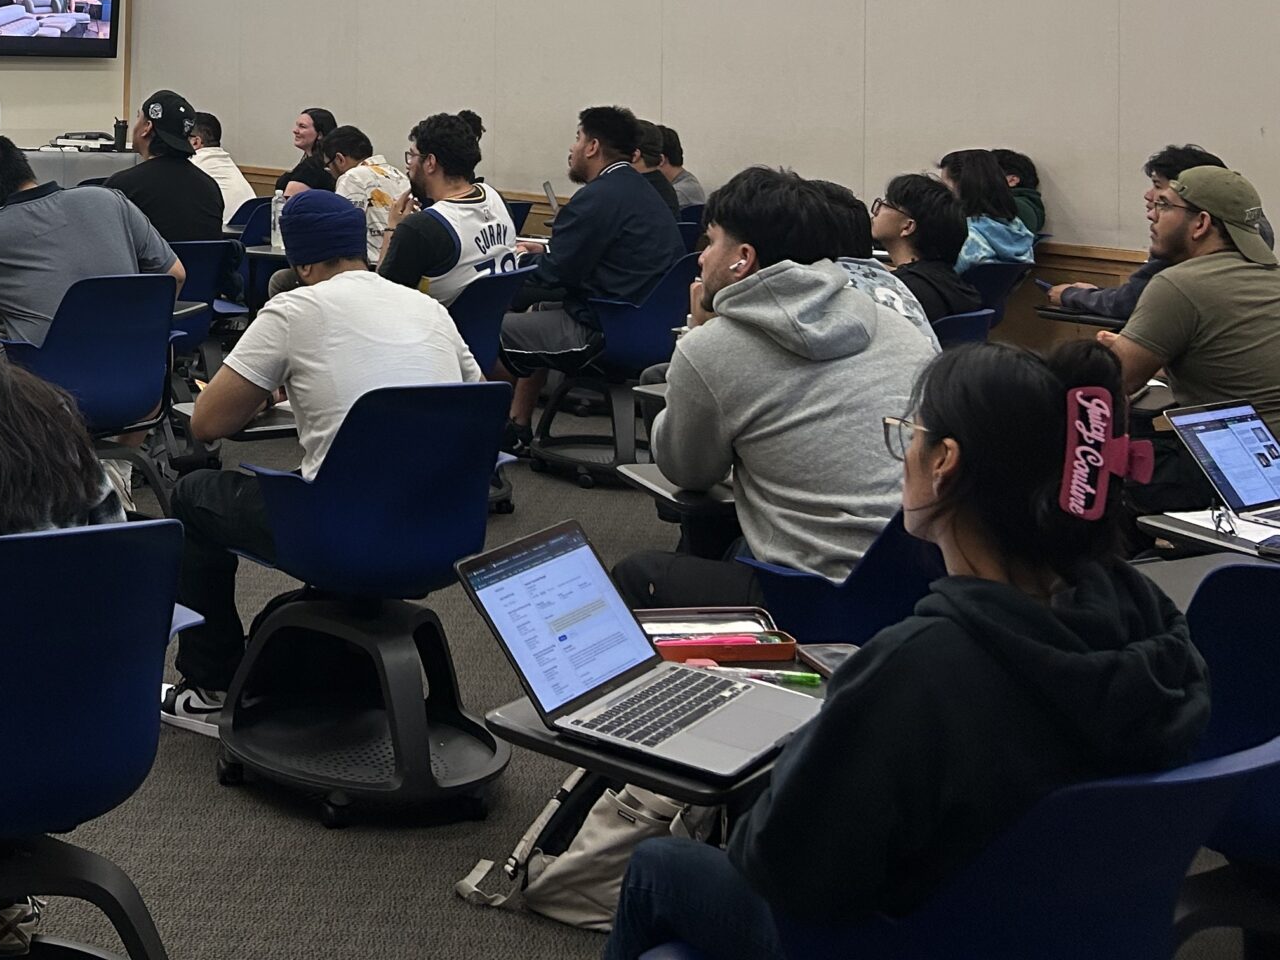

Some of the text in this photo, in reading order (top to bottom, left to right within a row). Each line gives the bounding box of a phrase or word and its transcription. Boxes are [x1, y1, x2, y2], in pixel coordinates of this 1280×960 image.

[474, 223, 507, 255] CURRY
[1069, 391, 1110, 515] Juicy Couture
